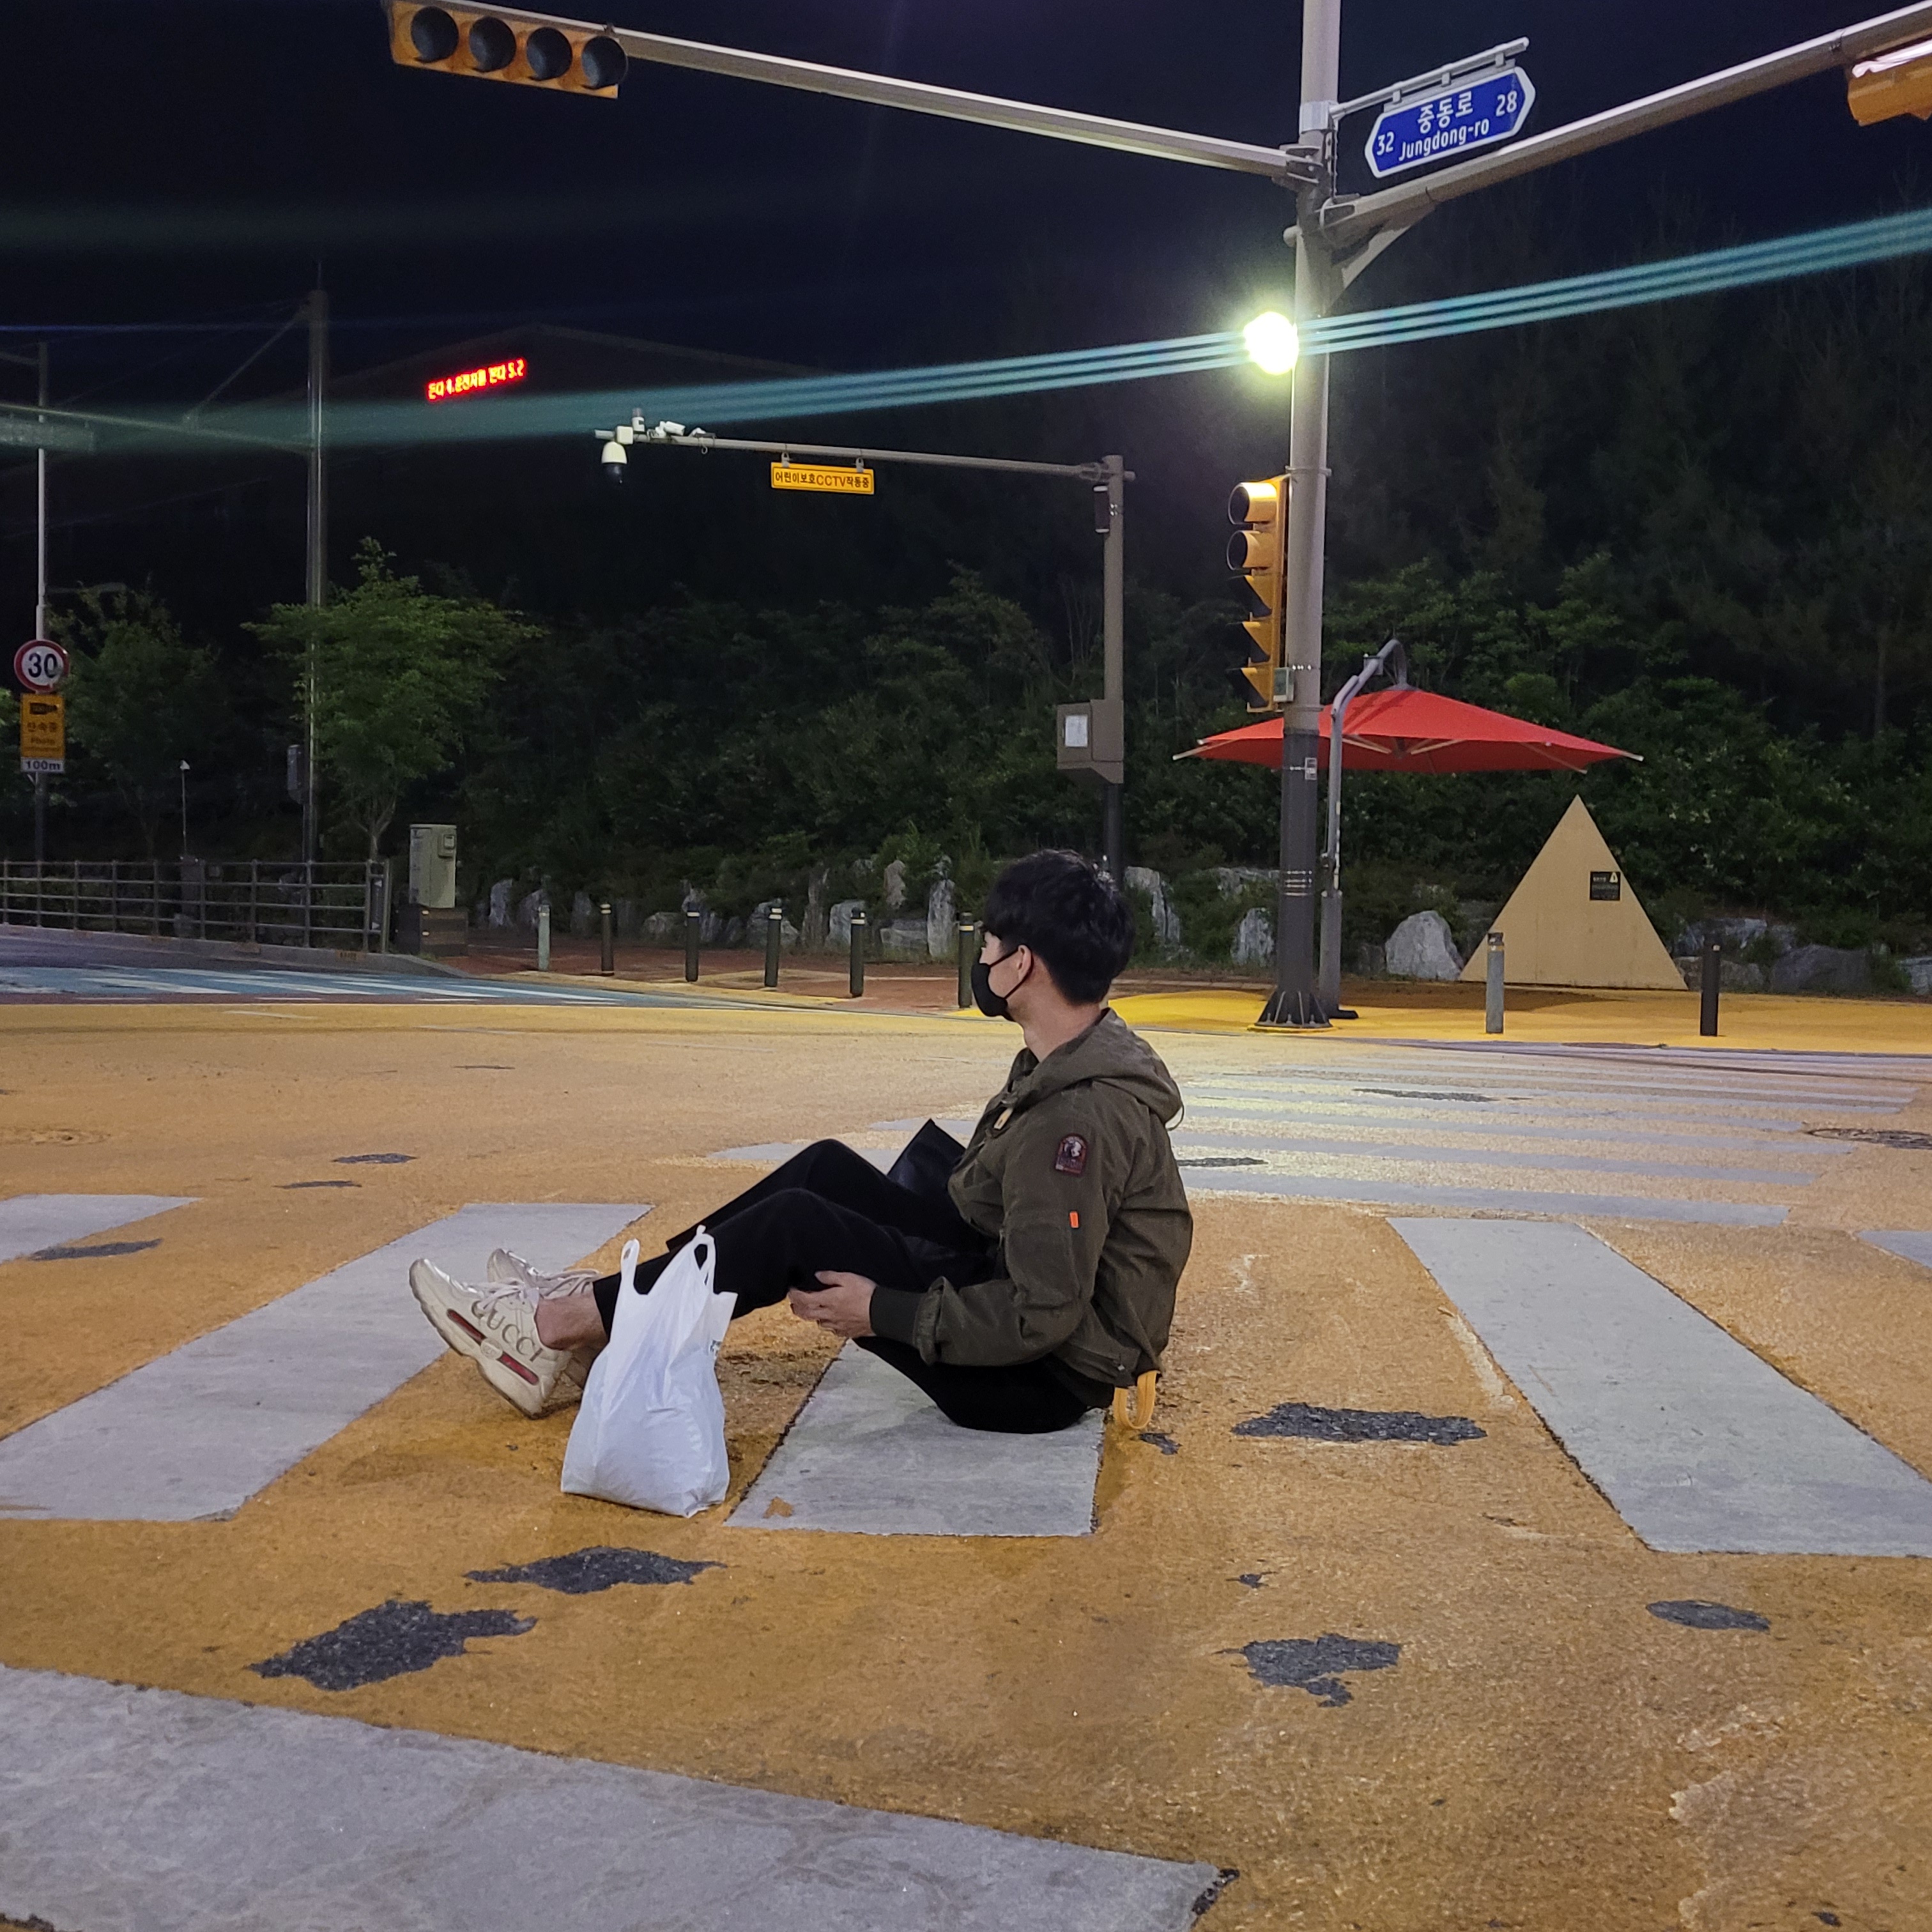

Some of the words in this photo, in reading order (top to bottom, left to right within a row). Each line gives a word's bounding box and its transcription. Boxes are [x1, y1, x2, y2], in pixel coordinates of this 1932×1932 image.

[1417, 91, 1474, 134] 중동로
[1495, 90, 1518, 117] 28
[1376, 132, 1395, 156] 32
[1398, 118, 1490, 162] Jungdong-ro
[27, 652, 58, 678] 30
[26, 760, 61, 771] 100m
